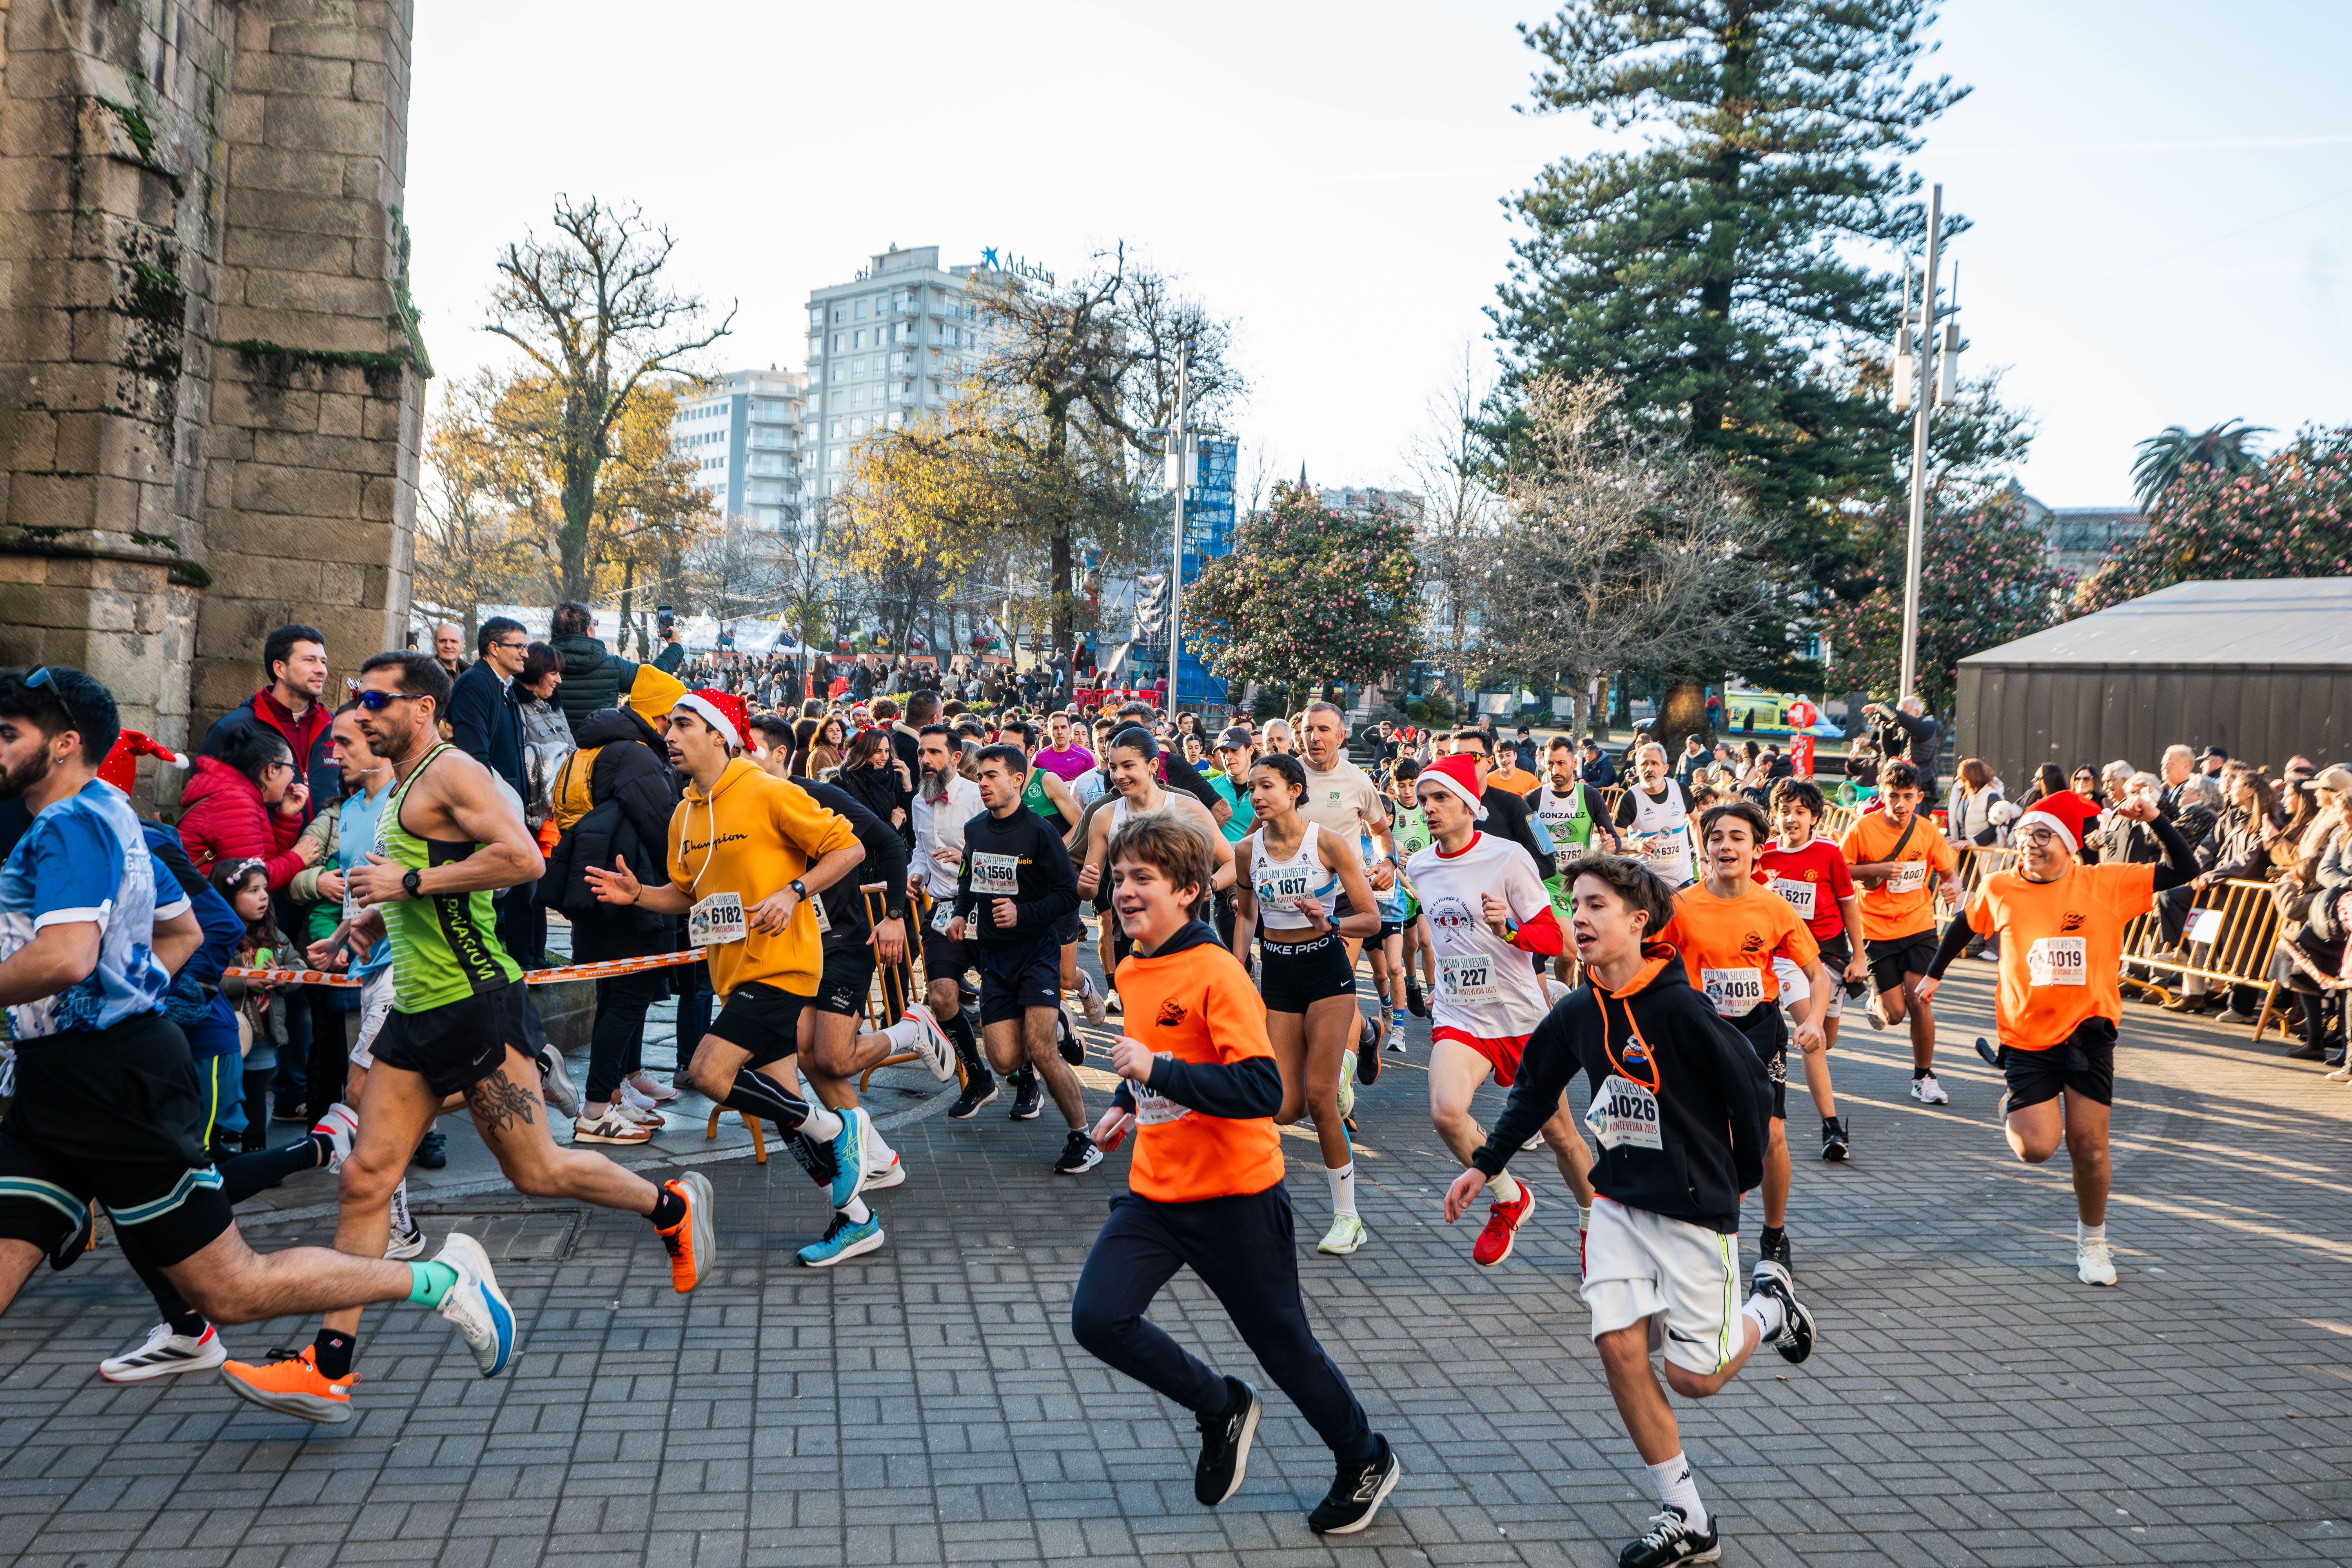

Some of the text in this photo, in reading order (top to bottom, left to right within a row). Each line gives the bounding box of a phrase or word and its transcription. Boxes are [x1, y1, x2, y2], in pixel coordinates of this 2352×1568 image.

[1662, 845, 1679, 855] 6374
[983, 855, 992, 864] SAN
[993, 857, 1016, 867] SILVESTRE
[987, 865, 1013, 880] 1550
[1269, 869, 1279, 879] SAN
[1281, 867, 1309, 878] SILVESTRE
[1903, 867, 1924, 880] 4007
[1278, 877, 1307, 895] 1817
[702, 896, 715, 908] SAN
[715, 895, 740, 906] SILVESTRE
[1785, 889, 1811, 905] 5217
[711, 906, 742, 924] 6182
[711, 924, 735, 933] PONTEVEDRA
[1264, 937, 1329, 955] NIKE PRO
[1448, 958, 1460, 969] SAN
[1461, 956, 1490, 968] SILVESTRE
[2047, 951, 2082, 967] 4019
[1461, 968, 1487, 987] 227
[1716, 971, 1729, 980] SAN
[1730, 970, 1758, 980] SILVESTRE
[1459, 985, 1497, 996] PONTEVEDRA 2025
[1725, 982, 1759, 998] 4018
[1608, 1094, 1656, 1122] 4026
[1610, 1120, 1657, 1134] PONTEVEDRA 2025
